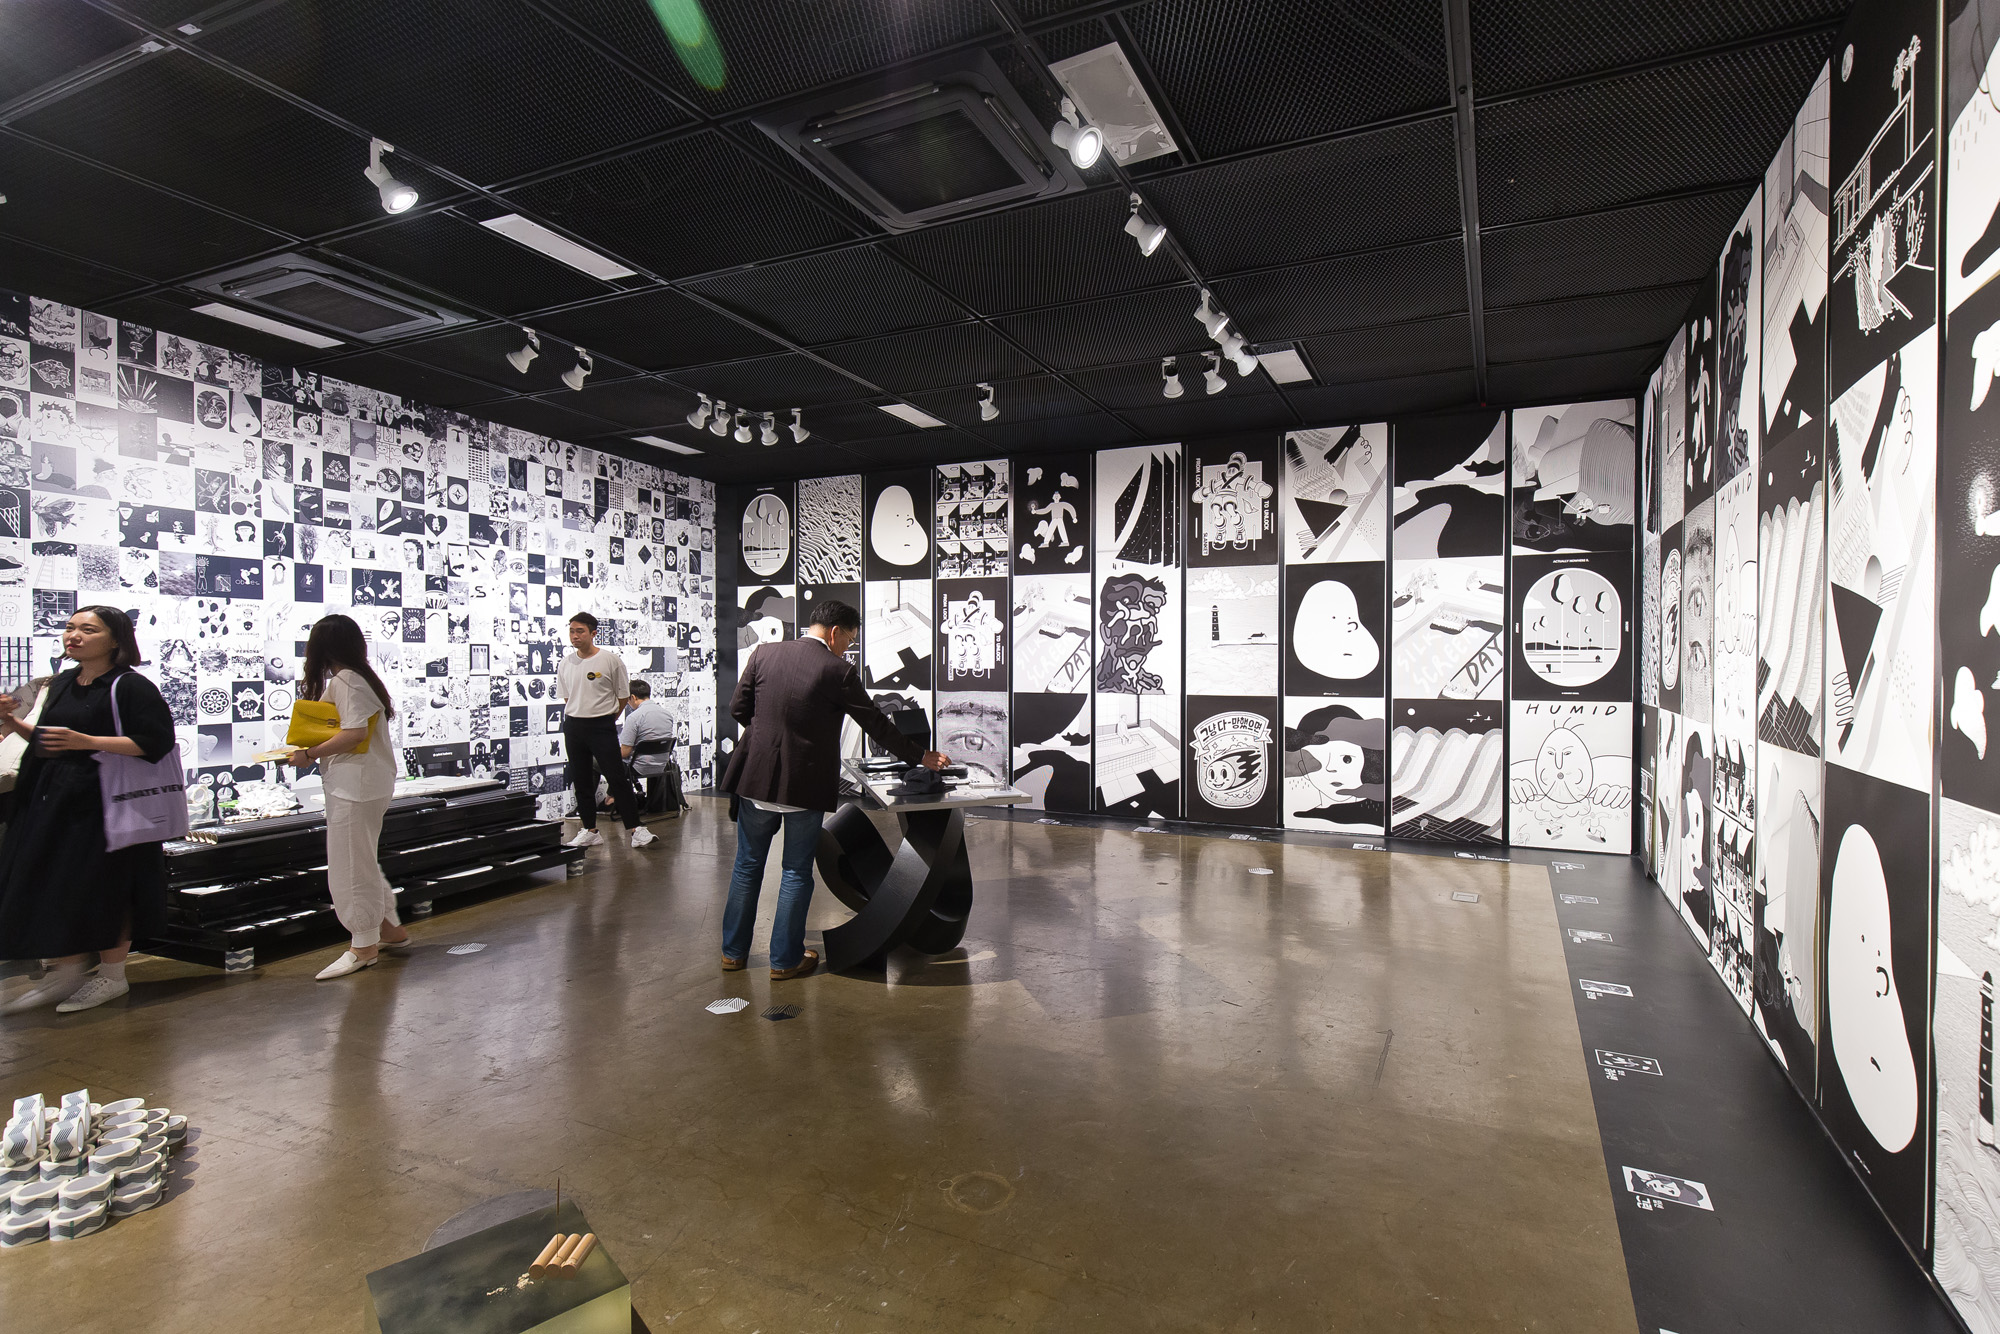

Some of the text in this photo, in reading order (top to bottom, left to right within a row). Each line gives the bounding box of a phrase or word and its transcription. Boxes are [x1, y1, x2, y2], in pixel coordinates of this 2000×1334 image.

[1064, 640, 1091, 683] DAY
[1465, 637, 1503, 687] DAY
[1525, 703, 1618, 716] HUMID
